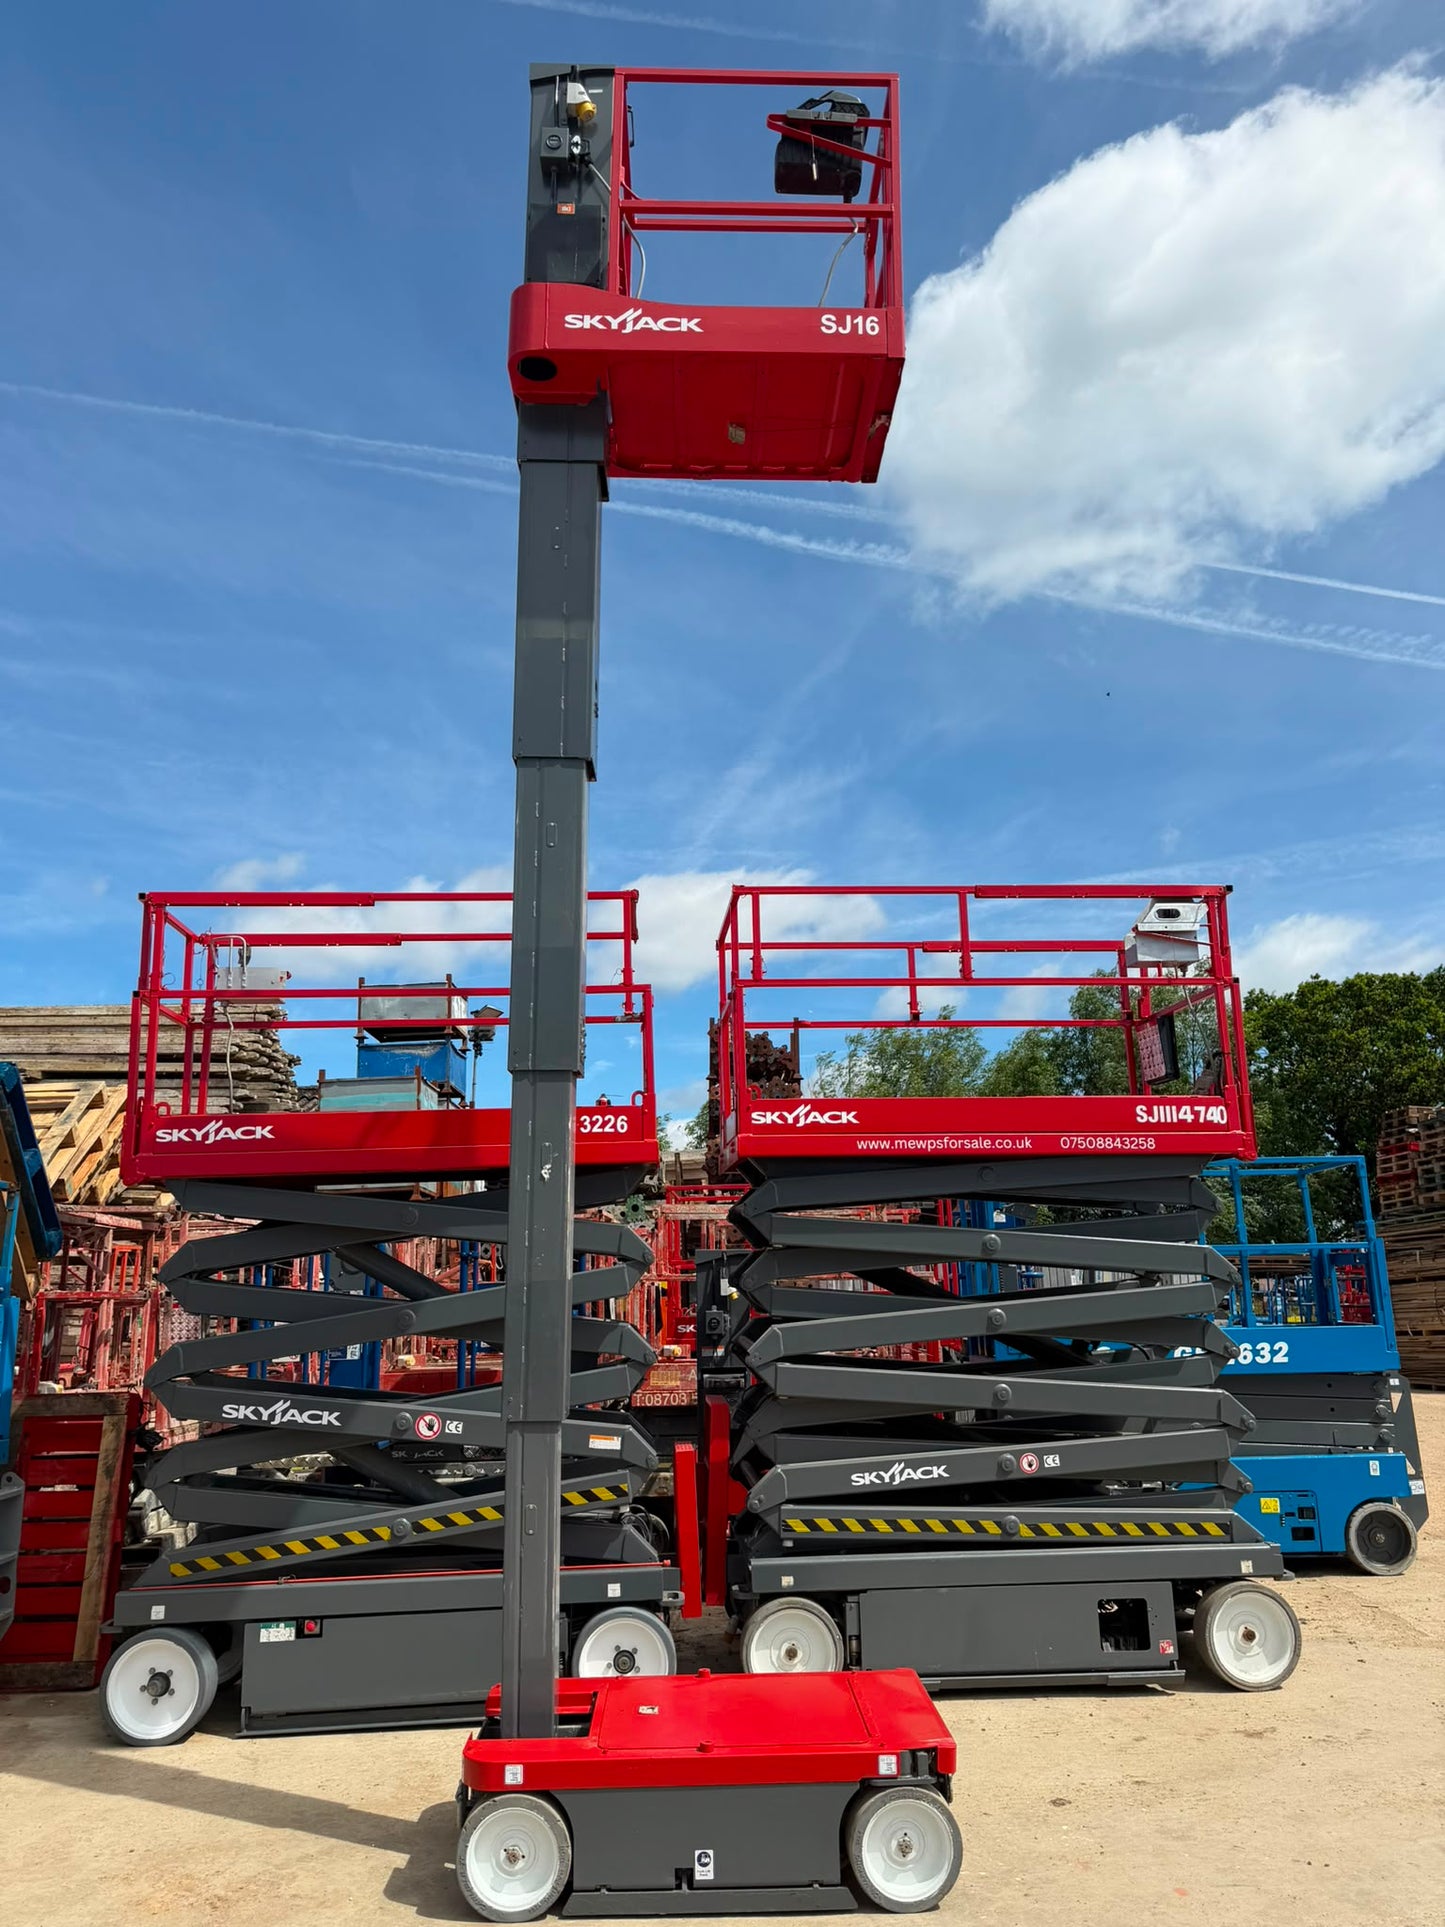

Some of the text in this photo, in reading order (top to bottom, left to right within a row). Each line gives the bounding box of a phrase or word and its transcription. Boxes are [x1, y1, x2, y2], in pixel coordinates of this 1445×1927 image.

[564, 308, 703, 333] SKYJACK
[820, 314, 880, 336] SJ16
[580, 1115, 628, 1133] 3226
[751, 1104, 860, 1127] SKYJACK
[155, 1120, 275, 1145] SKYJACK
[856, 1136, 1156, 1152] www.mewpsforsale.co.uk 07508843258
[222, 1400, 342, 1426] SKYJACK
[447, 1421, 462, 1433] CE
[851, 1462, 950, 1486] SKYJACK
